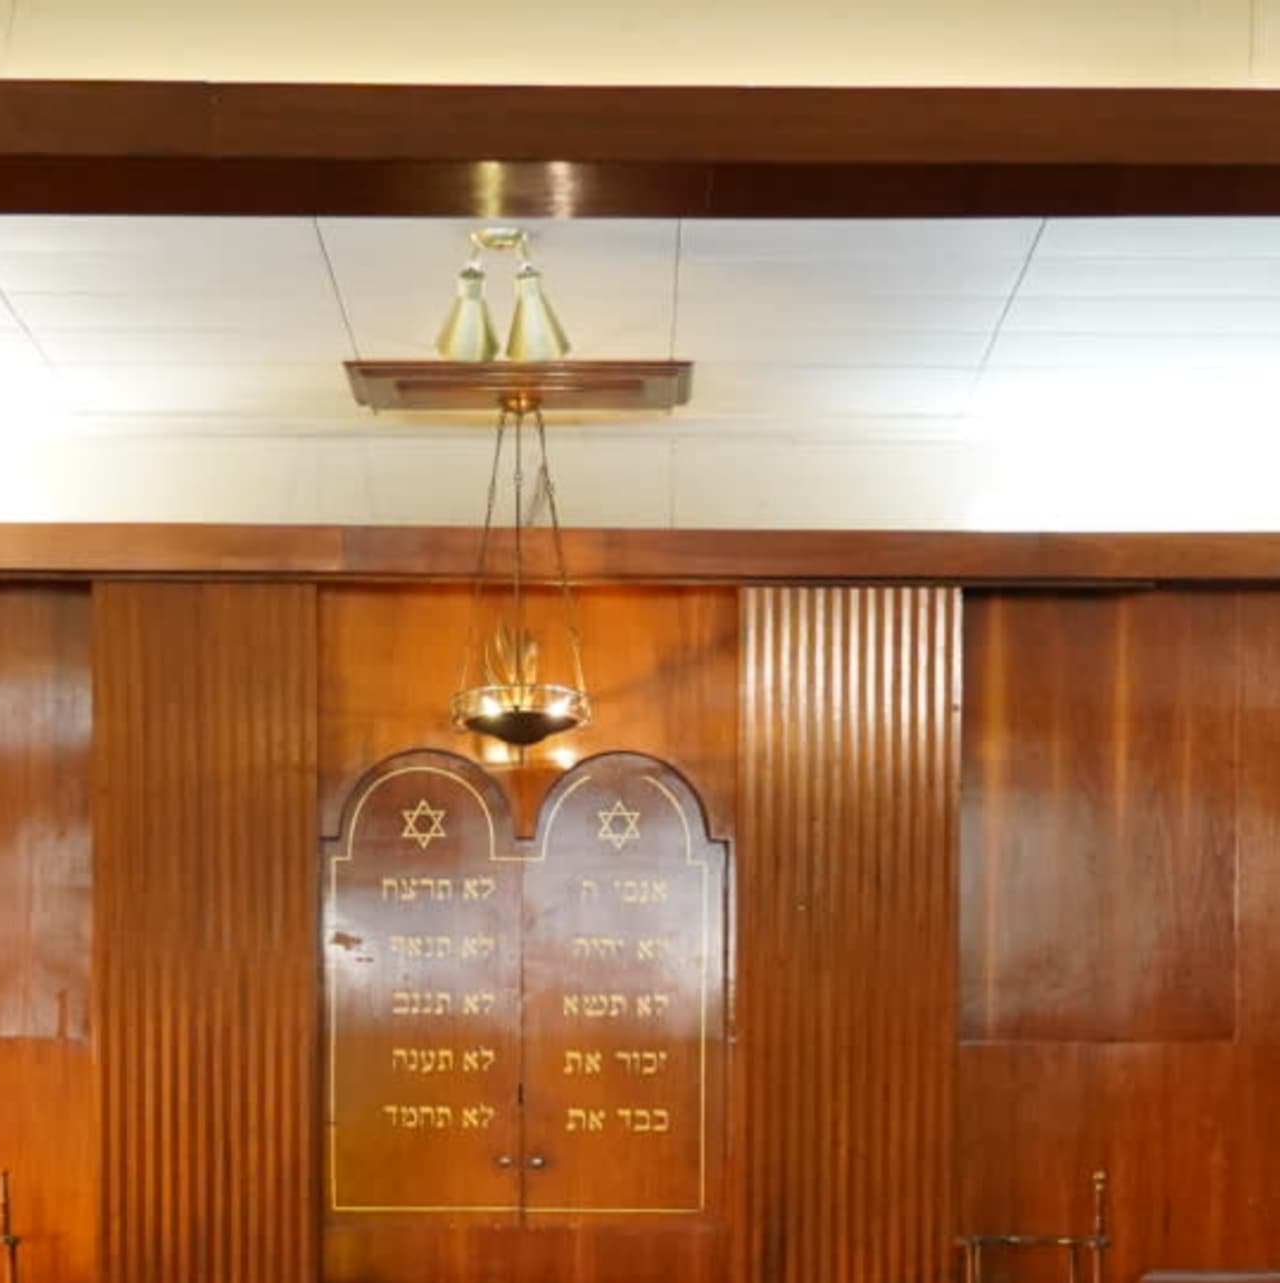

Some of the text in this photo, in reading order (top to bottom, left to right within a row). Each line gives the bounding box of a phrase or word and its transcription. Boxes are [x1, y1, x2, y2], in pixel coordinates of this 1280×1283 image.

[382, 873, 496, 901] לא תרצח
[462, 932, 496, 958] לא
[463, 988, 495, 1014] לא
[563, 990, 670, 1018] לא תשא
[392, 1045, 495, 1073] לא תענה
[563, 1050, 602, 1074] את
[383, 1101, 495, 1129] לא תחמד
[565, 1108, 669, 1131] כבד את
